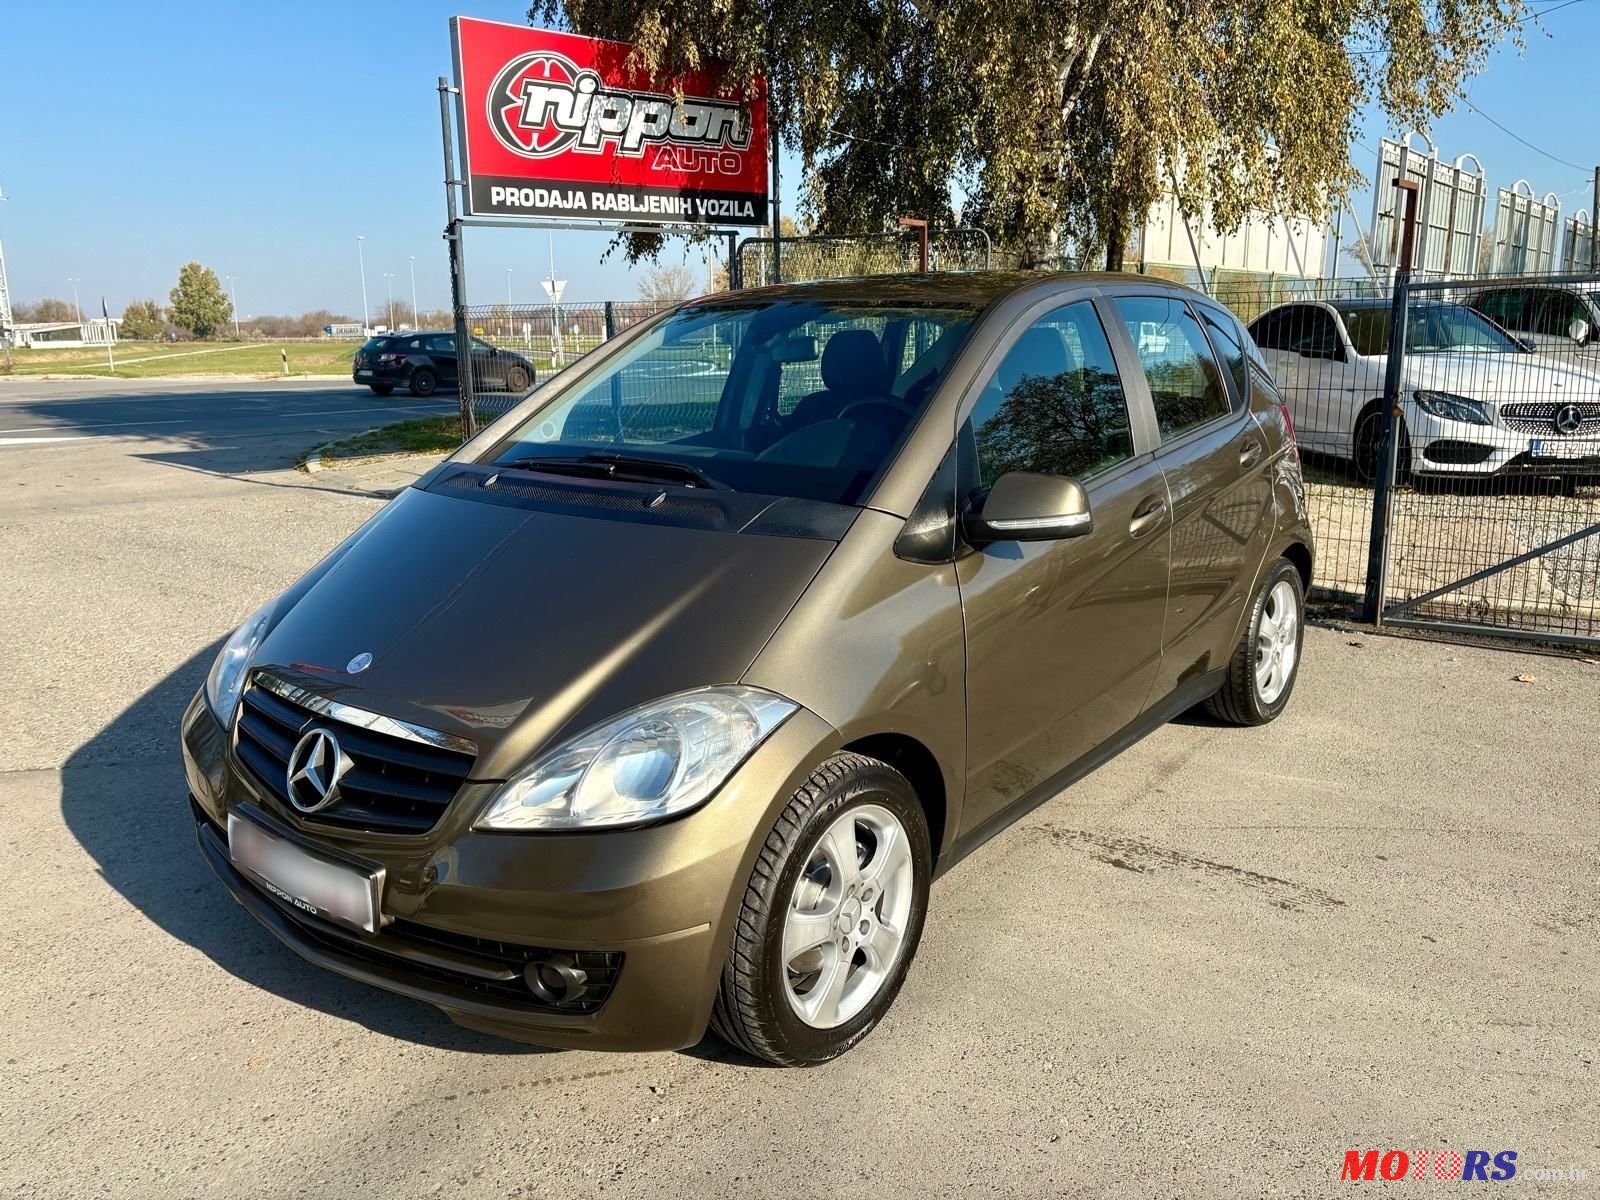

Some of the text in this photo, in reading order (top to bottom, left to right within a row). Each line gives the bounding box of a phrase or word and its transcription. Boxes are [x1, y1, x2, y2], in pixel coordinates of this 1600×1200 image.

[520, 74, 752, 153] nippon
[651, 145, 741, 175] AUTO
[490, 186, 755, 218] PRODAJA RABLJENIH VOZILA
[265, 881, 317, 915] NIPPON AUTO
